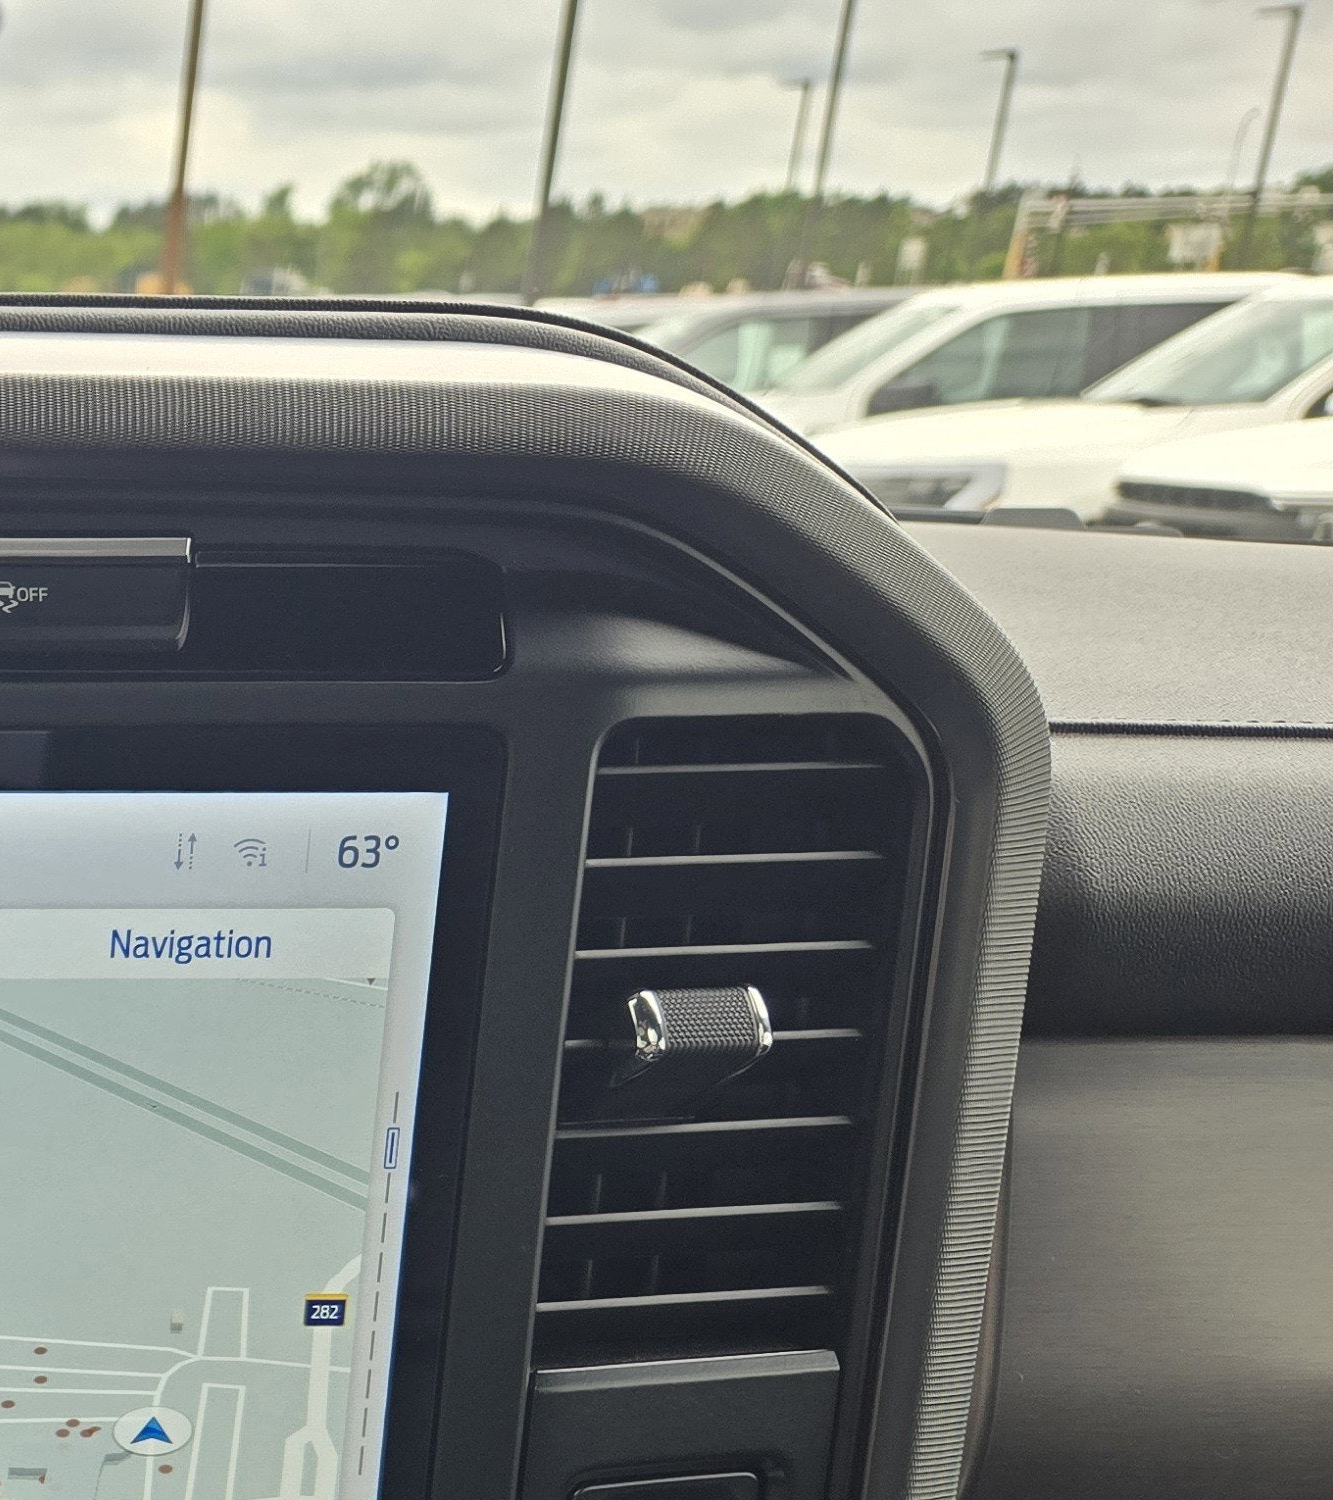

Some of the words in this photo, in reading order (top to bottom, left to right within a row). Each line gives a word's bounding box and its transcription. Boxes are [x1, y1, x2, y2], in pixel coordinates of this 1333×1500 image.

[16, 587, 49, 602] OFF
[337, 834, 401, 871] 63°
[110, 929, 273, 965] Navigation
[311, 1304, 339, 1321] 282
